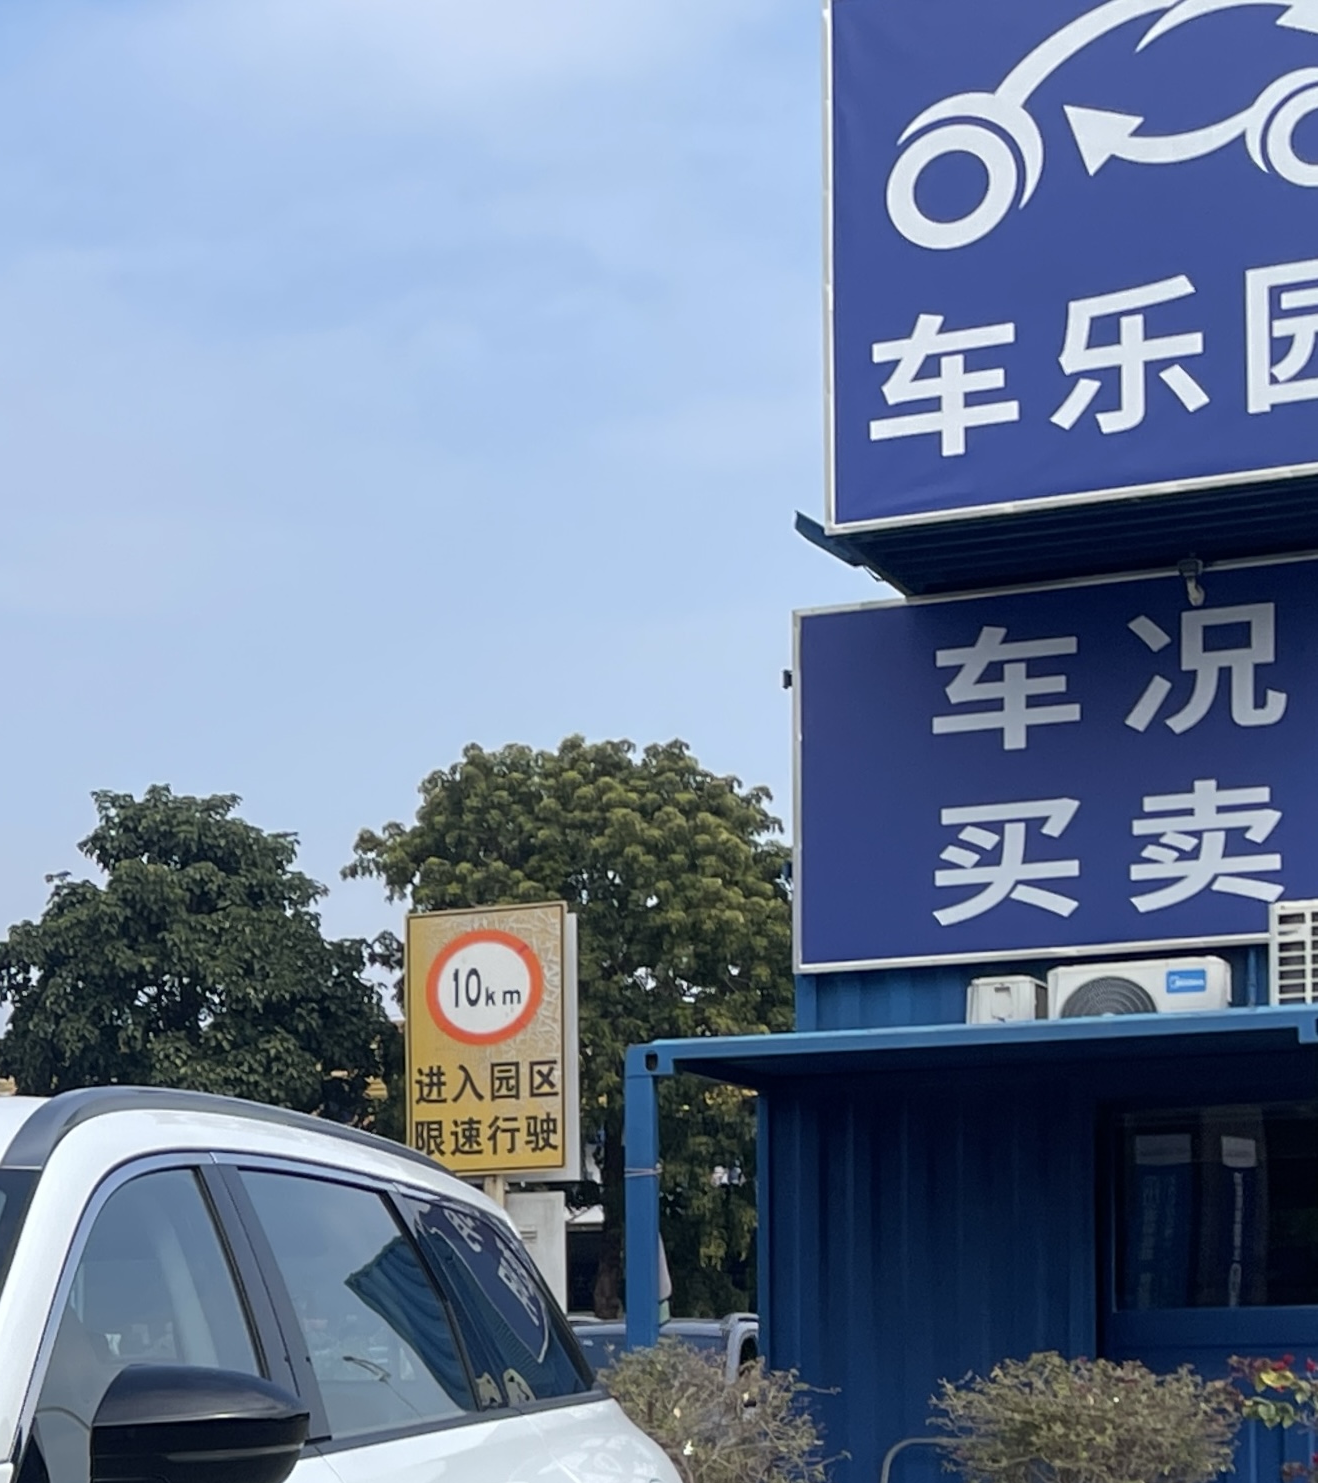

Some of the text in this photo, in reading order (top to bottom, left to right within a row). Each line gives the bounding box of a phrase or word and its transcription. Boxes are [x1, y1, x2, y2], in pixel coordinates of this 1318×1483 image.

[932, 602, 1288, 750] 车况
[932, 779, 1286, 927] 买卖
[414, 1060, 560, 1105] 进入园区
[414, 1112, 559, 1157] 限速行驶
